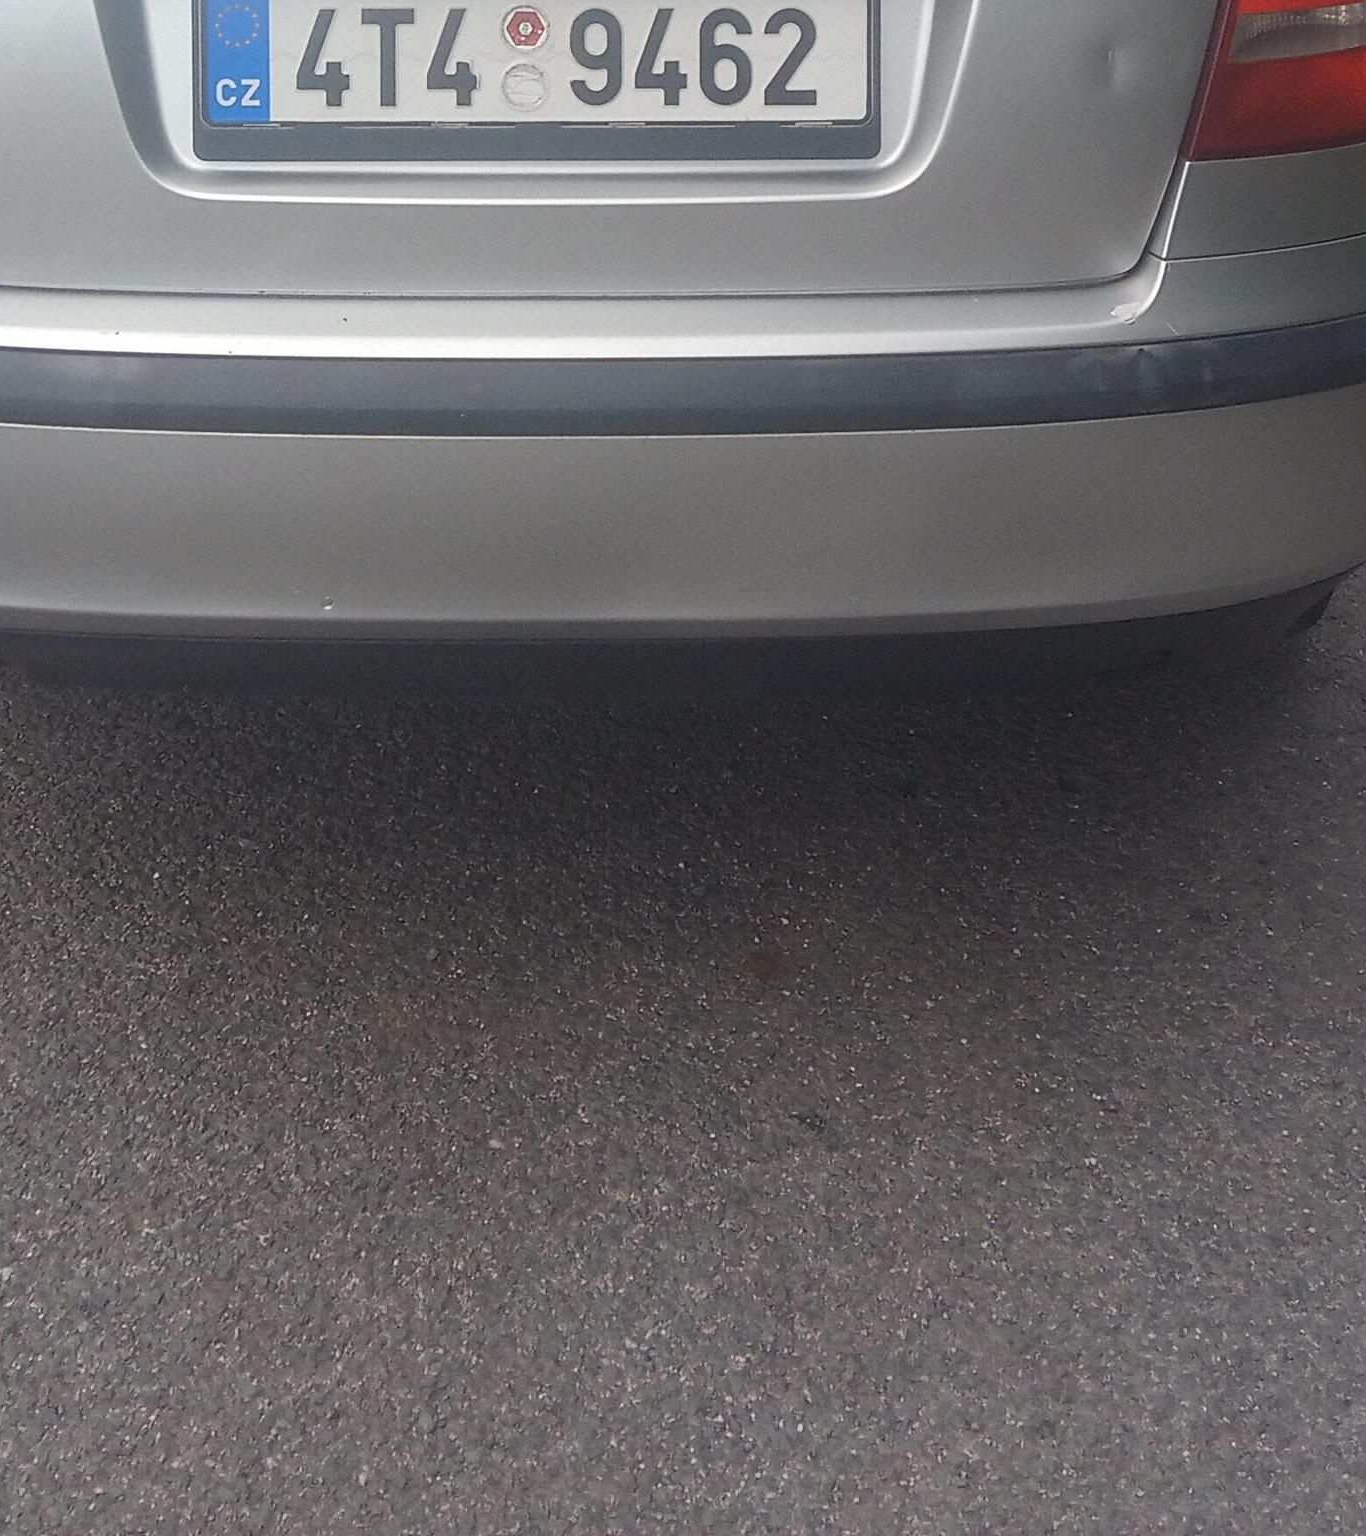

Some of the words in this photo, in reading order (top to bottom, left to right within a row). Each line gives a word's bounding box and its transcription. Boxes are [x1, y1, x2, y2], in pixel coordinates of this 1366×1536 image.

[296, 8, 479, 106] 4T4
[569, 8, 818, 106] 9462
[215, 78, 261, 107] CZ
